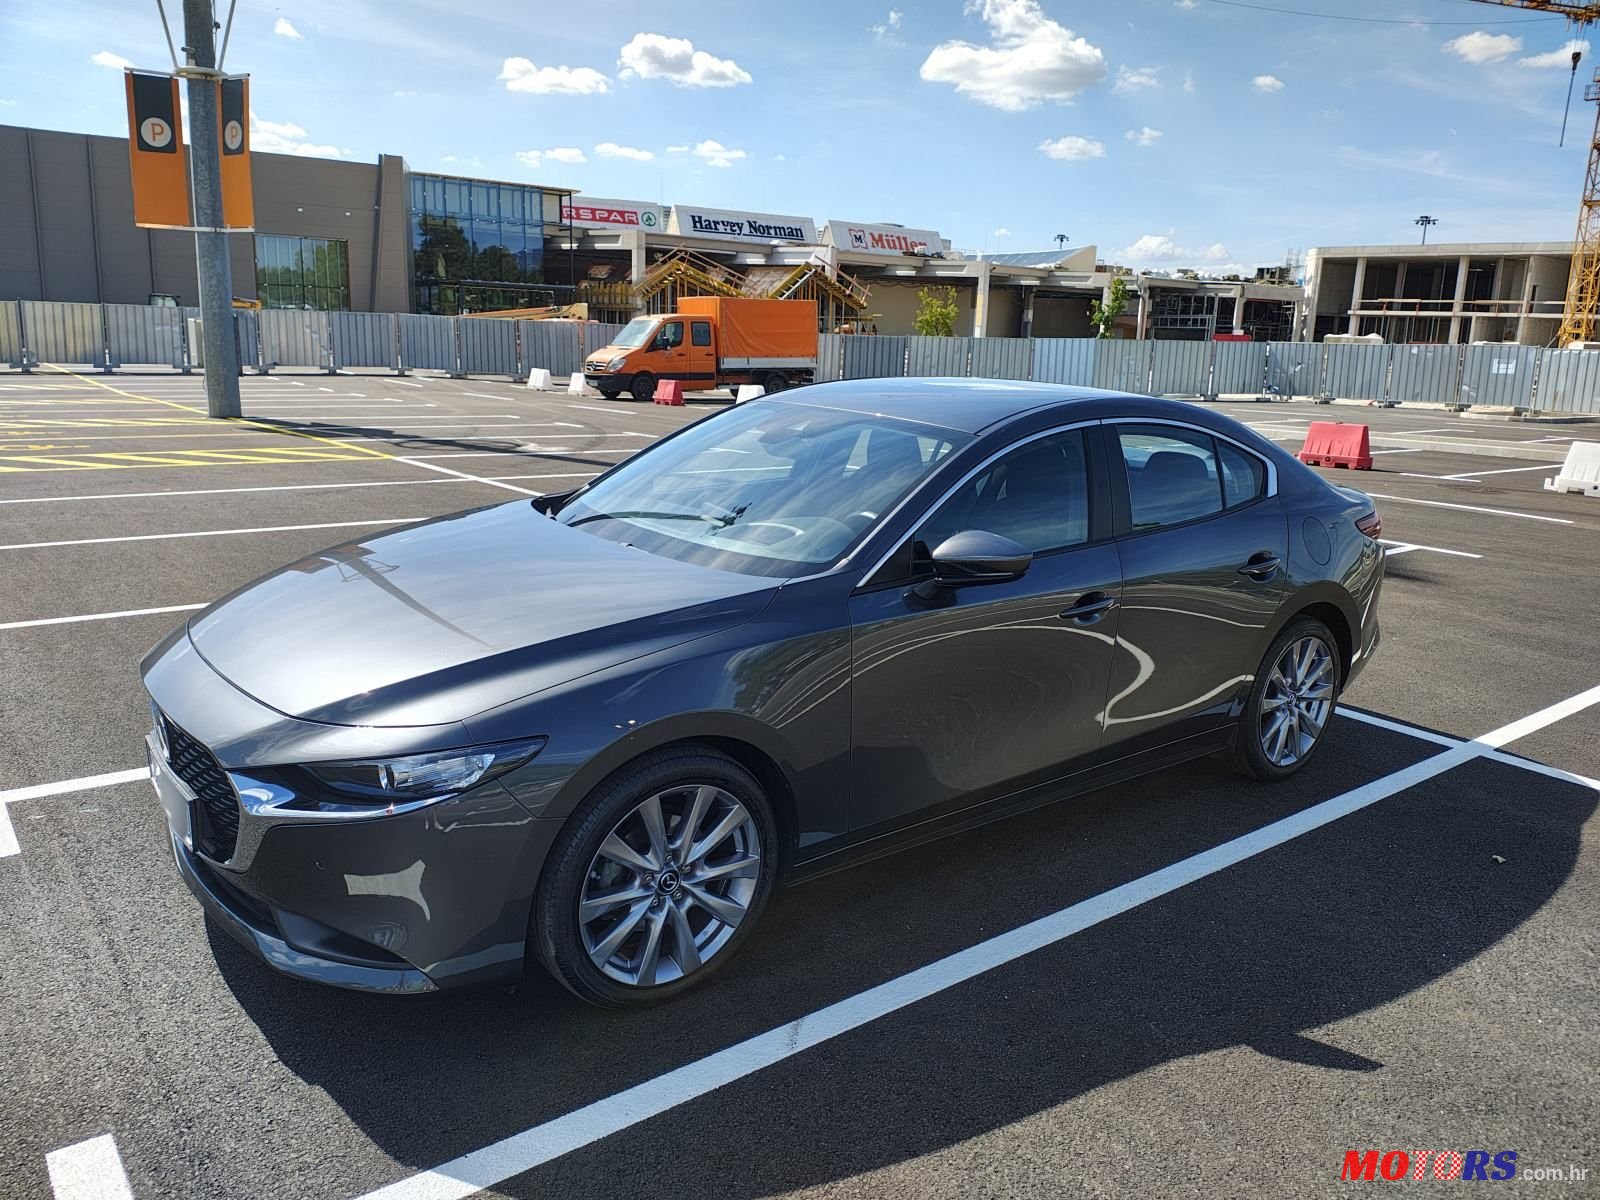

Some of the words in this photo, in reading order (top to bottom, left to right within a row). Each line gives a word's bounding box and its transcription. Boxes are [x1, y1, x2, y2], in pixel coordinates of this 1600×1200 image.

[151, 123, 164, 142] P
[230, 126, 238, 144] P
[690, 215, 744, 236] Harvey
[746, 220, 804, 239] Norman
